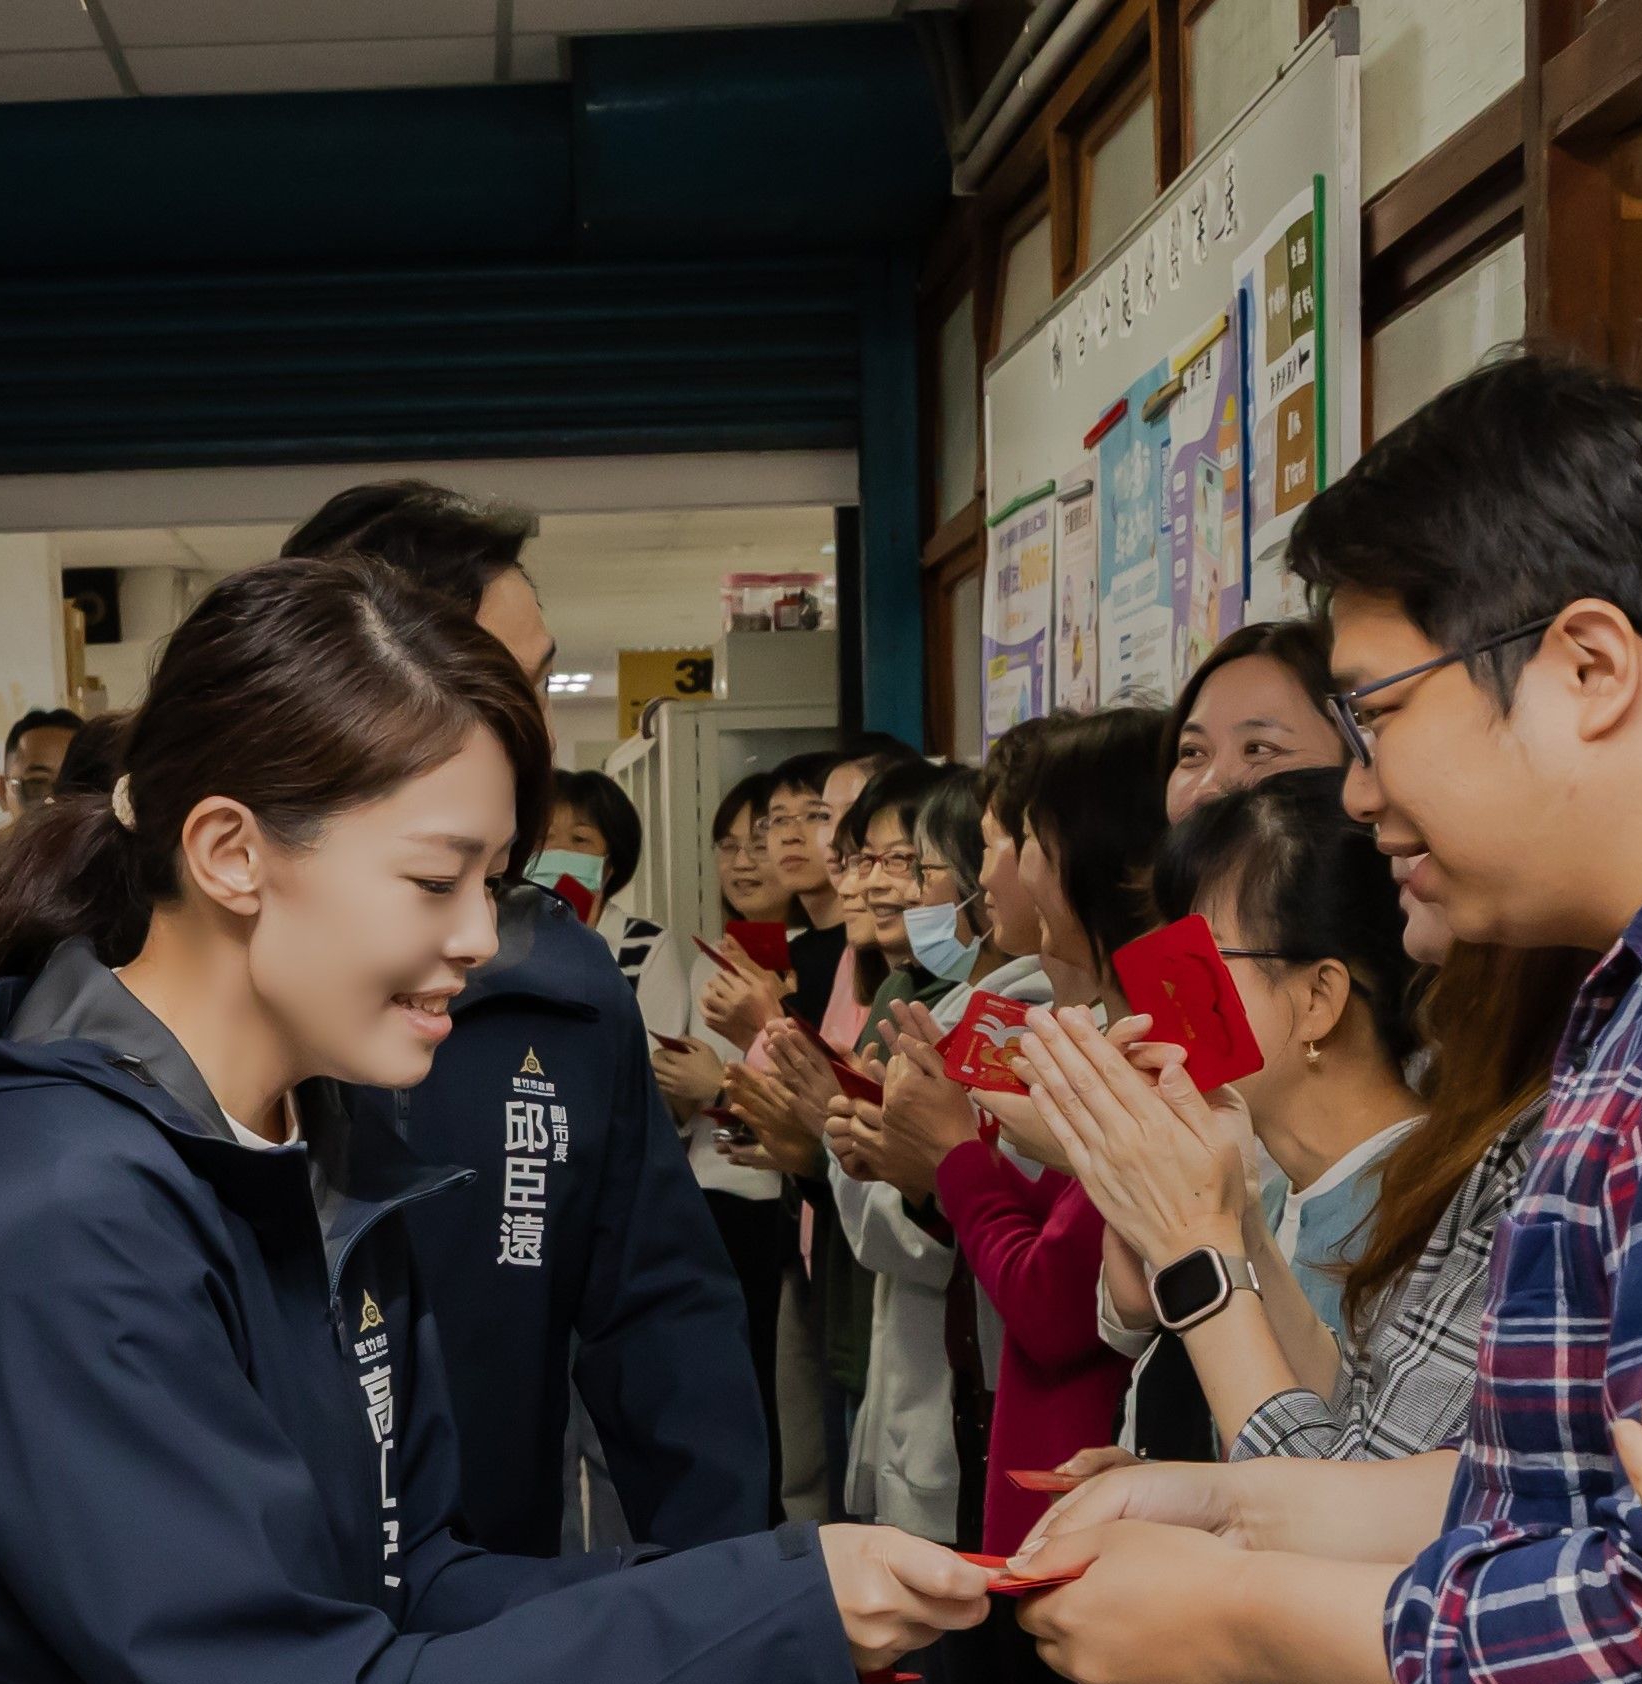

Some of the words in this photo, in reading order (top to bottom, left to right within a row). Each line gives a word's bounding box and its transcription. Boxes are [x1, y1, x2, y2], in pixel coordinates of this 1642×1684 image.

[549, 1104, 570, 1163] 副市長
[497, 1100, 549, 1267] 邱臣遠
[354, 1333, 388, 1357] 新竹市
